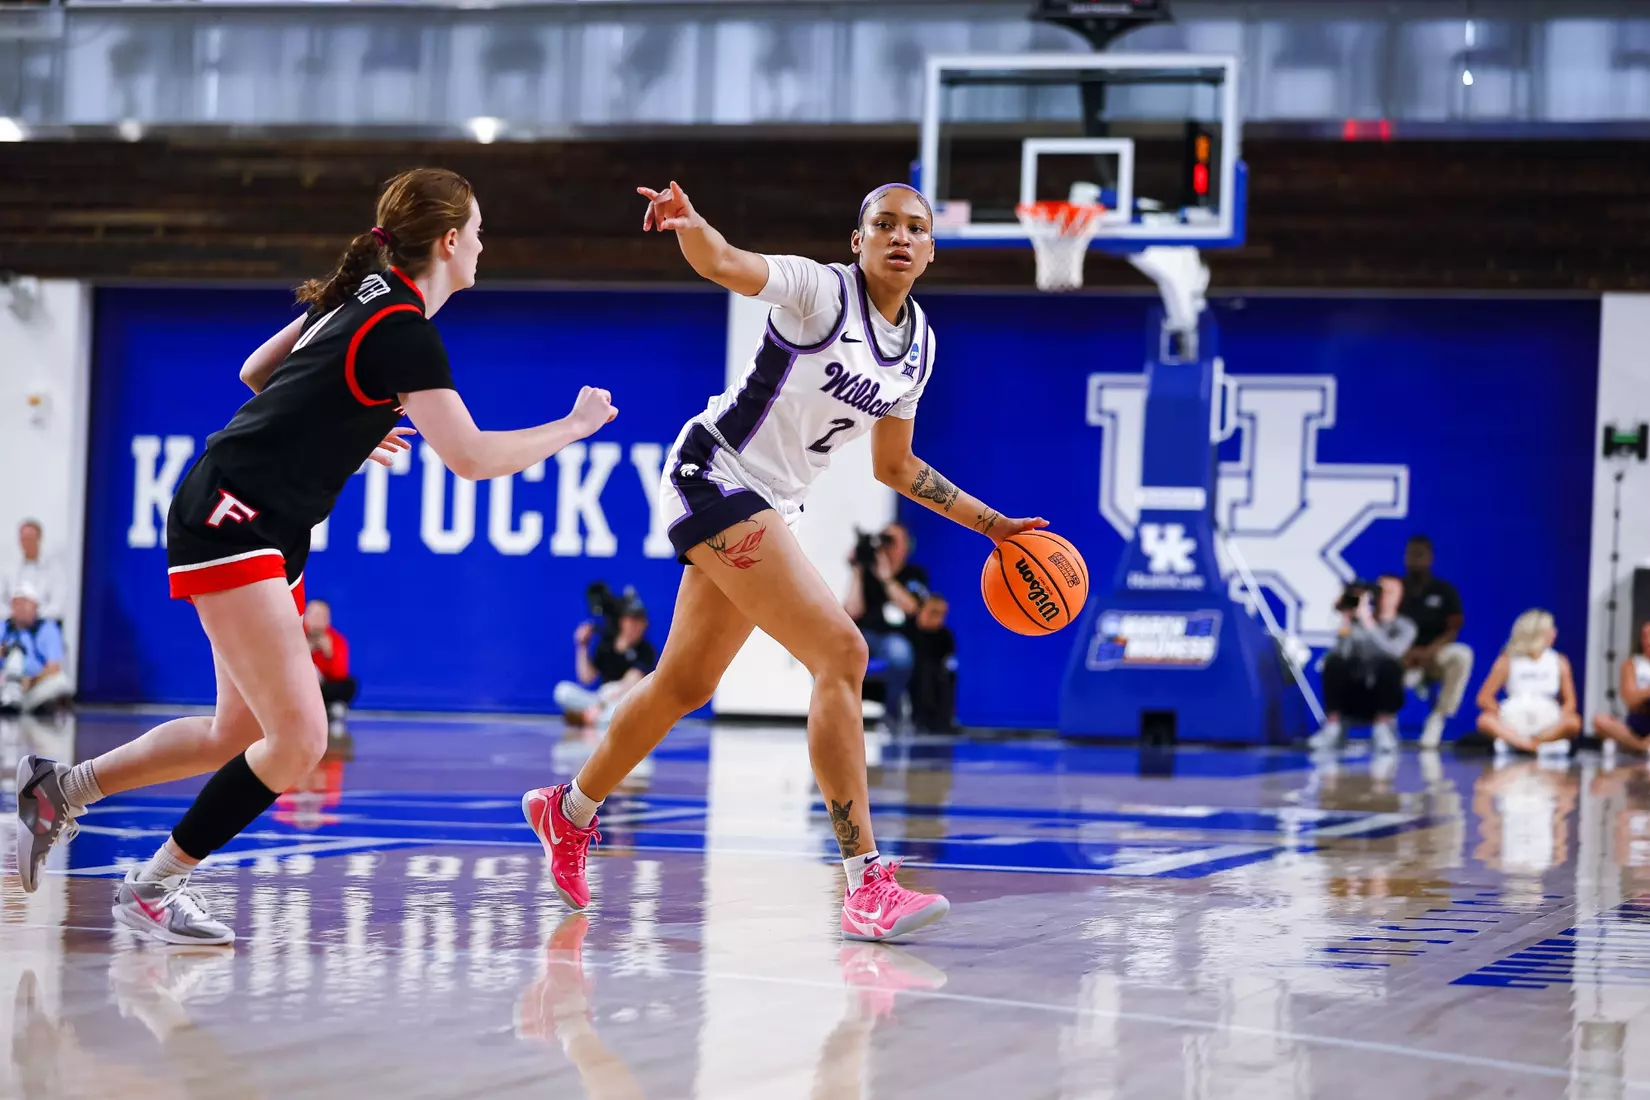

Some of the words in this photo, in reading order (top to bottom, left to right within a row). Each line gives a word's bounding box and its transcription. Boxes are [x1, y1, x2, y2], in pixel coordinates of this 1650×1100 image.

[806, 417, 856, 453] 2
[205, 488, 259, 528] F
[1015, 557, 1060, 622] Wilson
